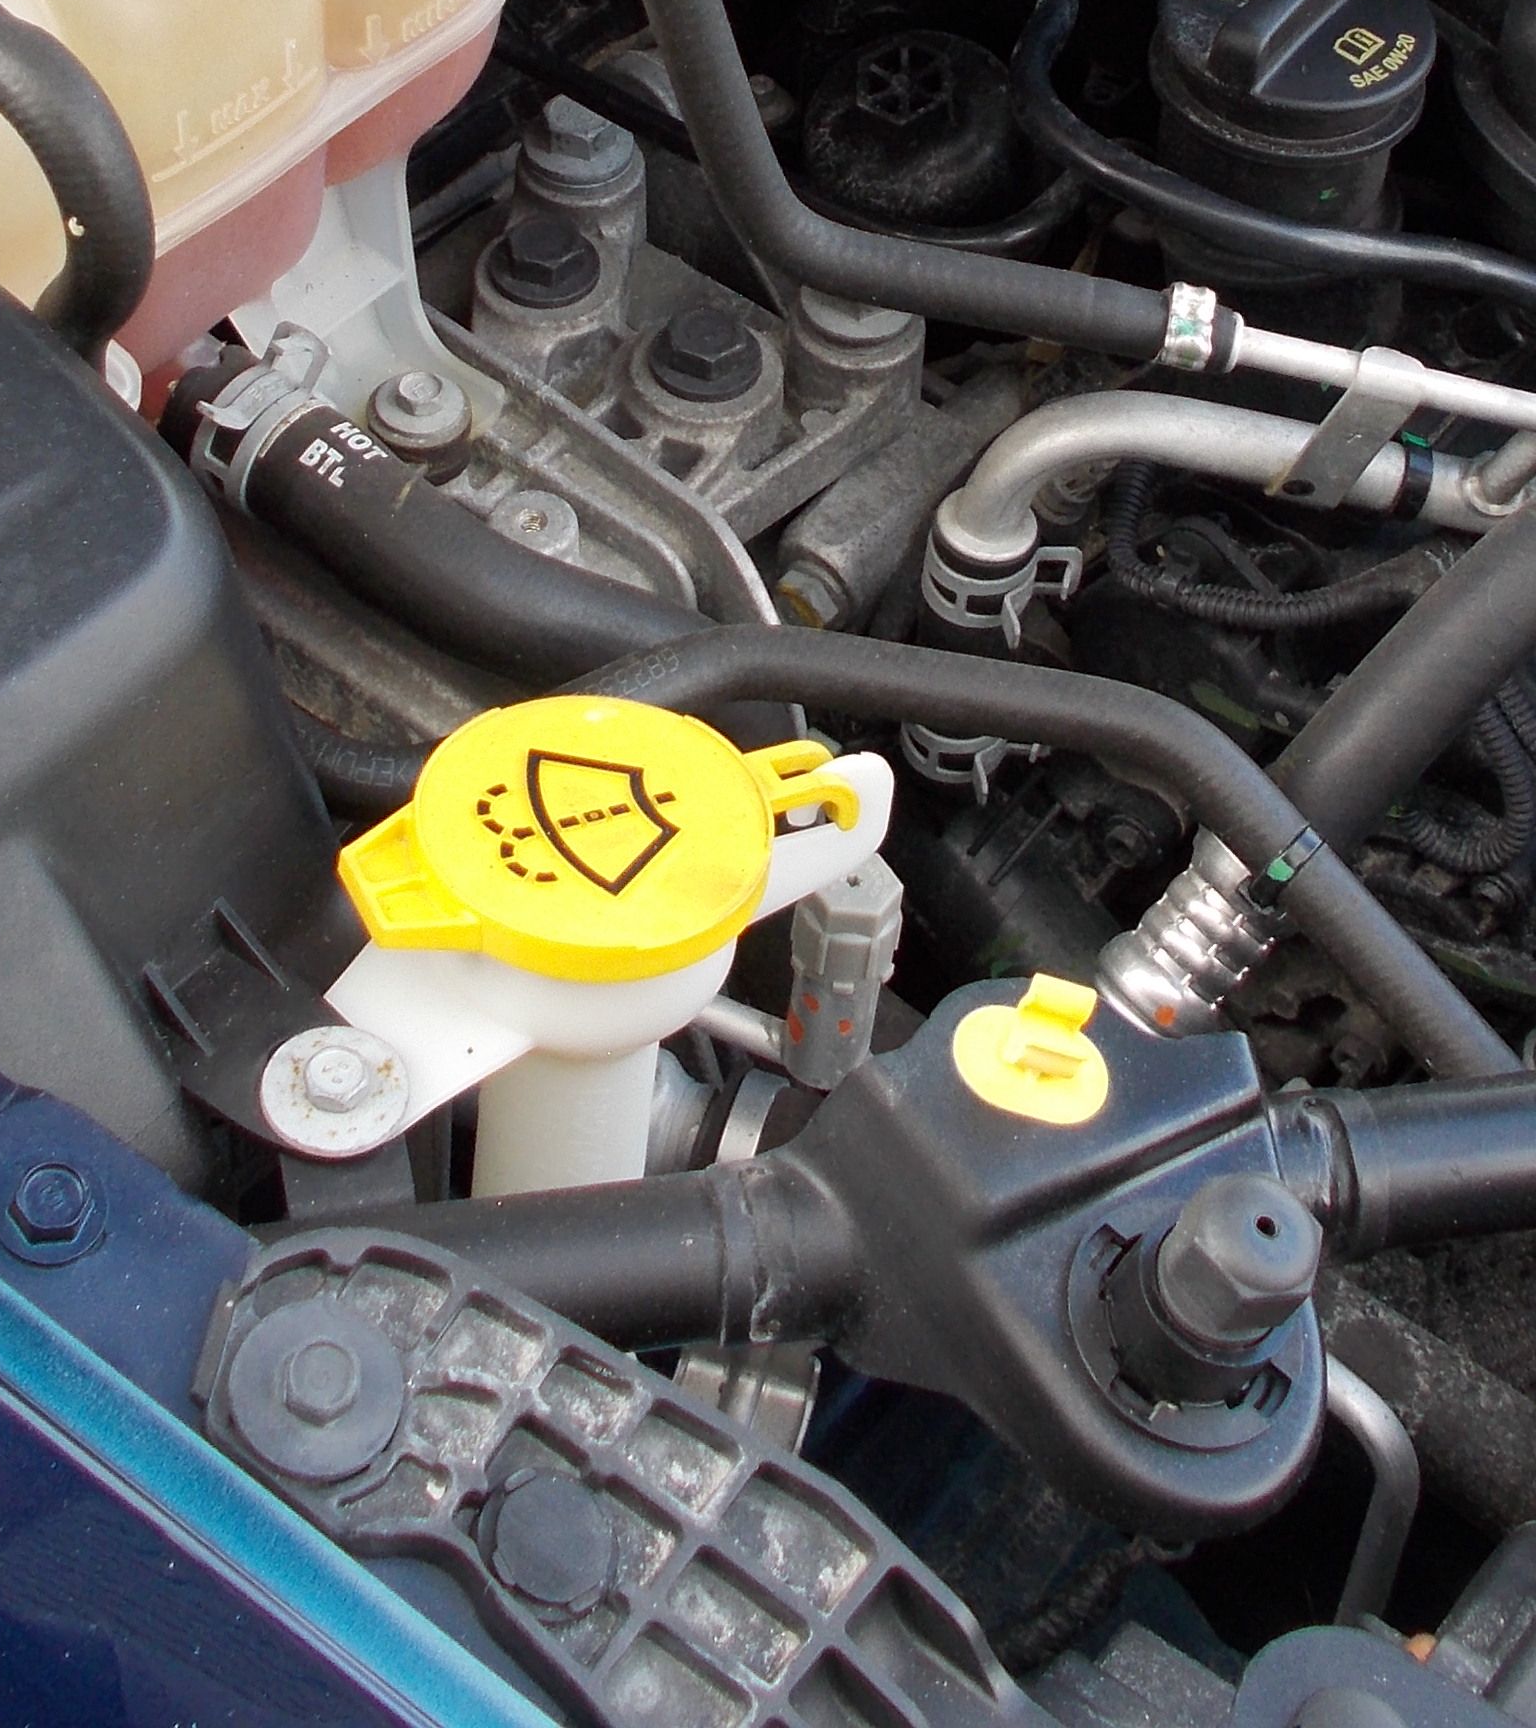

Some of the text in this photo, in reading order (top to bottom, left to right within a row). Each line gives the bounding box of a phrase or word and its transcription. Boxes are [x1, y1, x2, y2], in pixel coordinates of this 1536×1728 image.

[1349, 33, 1417, 89] SAE 0W-20
[329, 421, 389, 460] HOT
